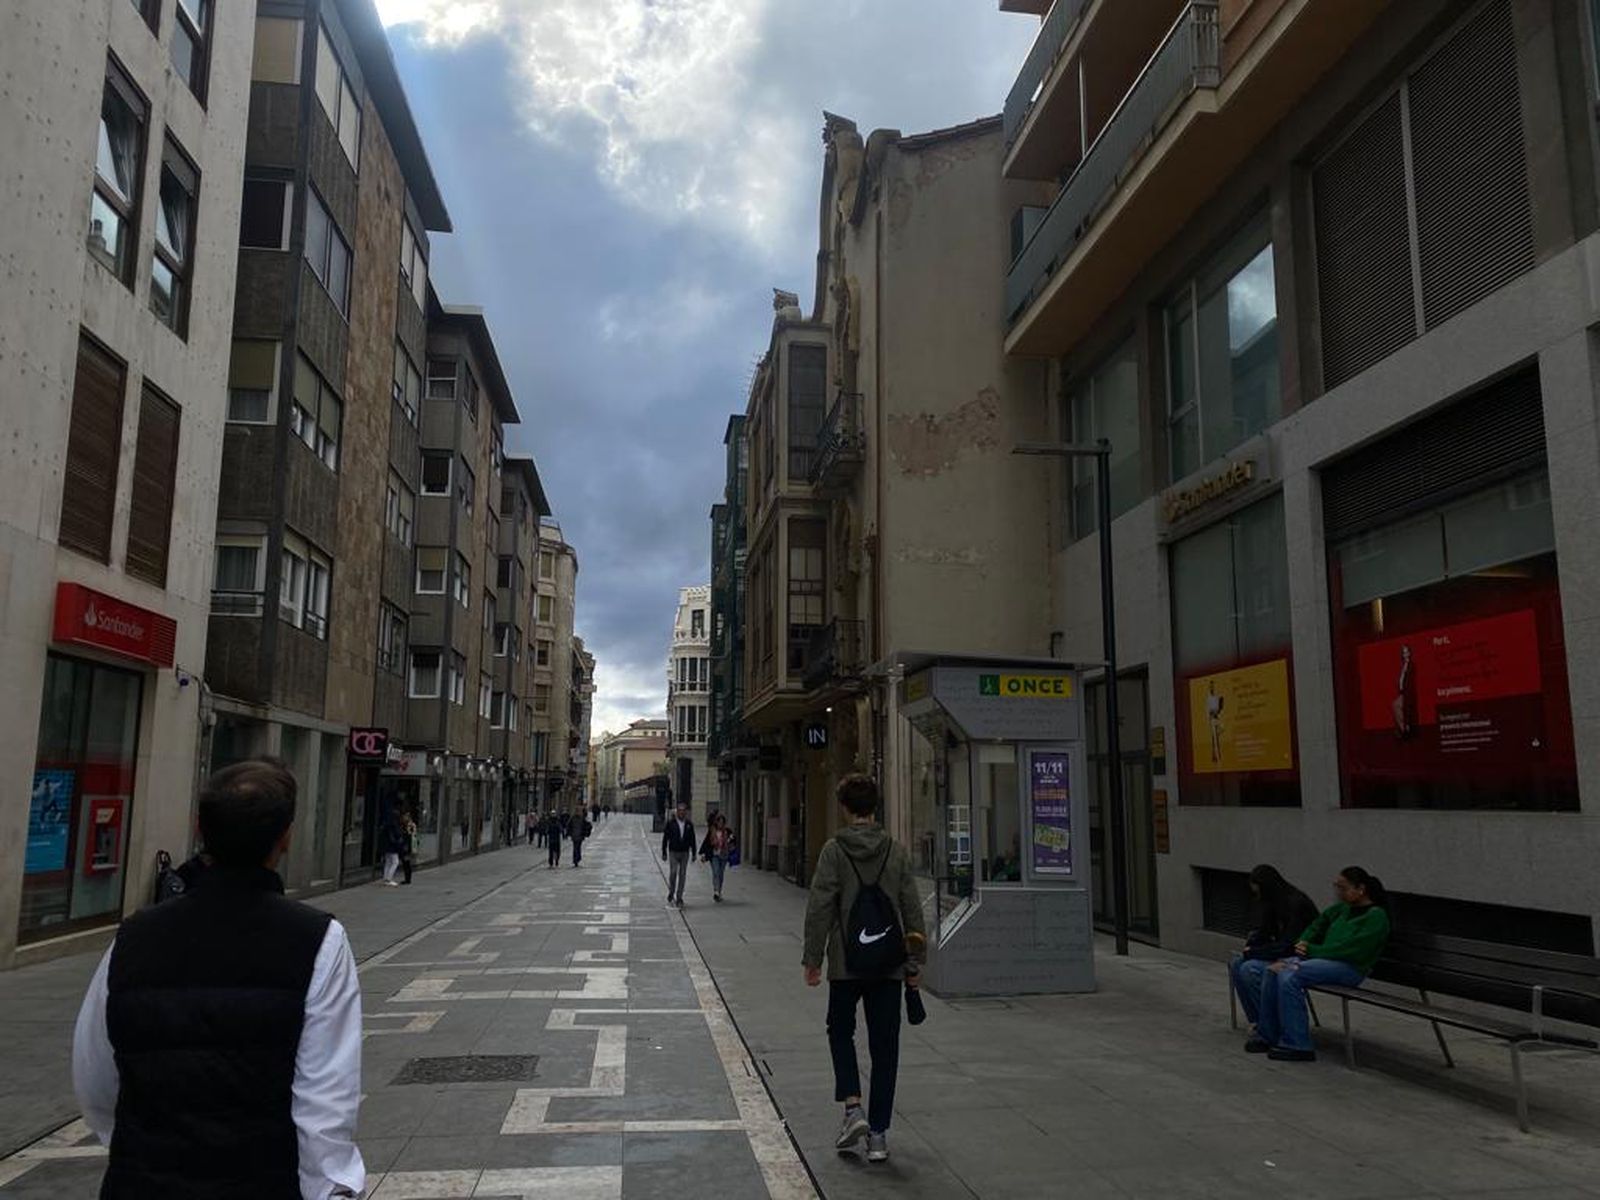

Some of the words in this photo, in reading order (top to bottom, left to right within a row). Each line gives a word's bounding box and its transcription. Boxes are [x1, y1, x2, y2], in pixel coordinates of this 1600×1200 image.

[1178, 460, 1255, 515] Santander
[97, 610, 146, 641] Santander
[1007, 679, 1064, 694] ONCE
[808, 728, 826, 744] IN
[1034, 761, 1063, 774] 11/11
